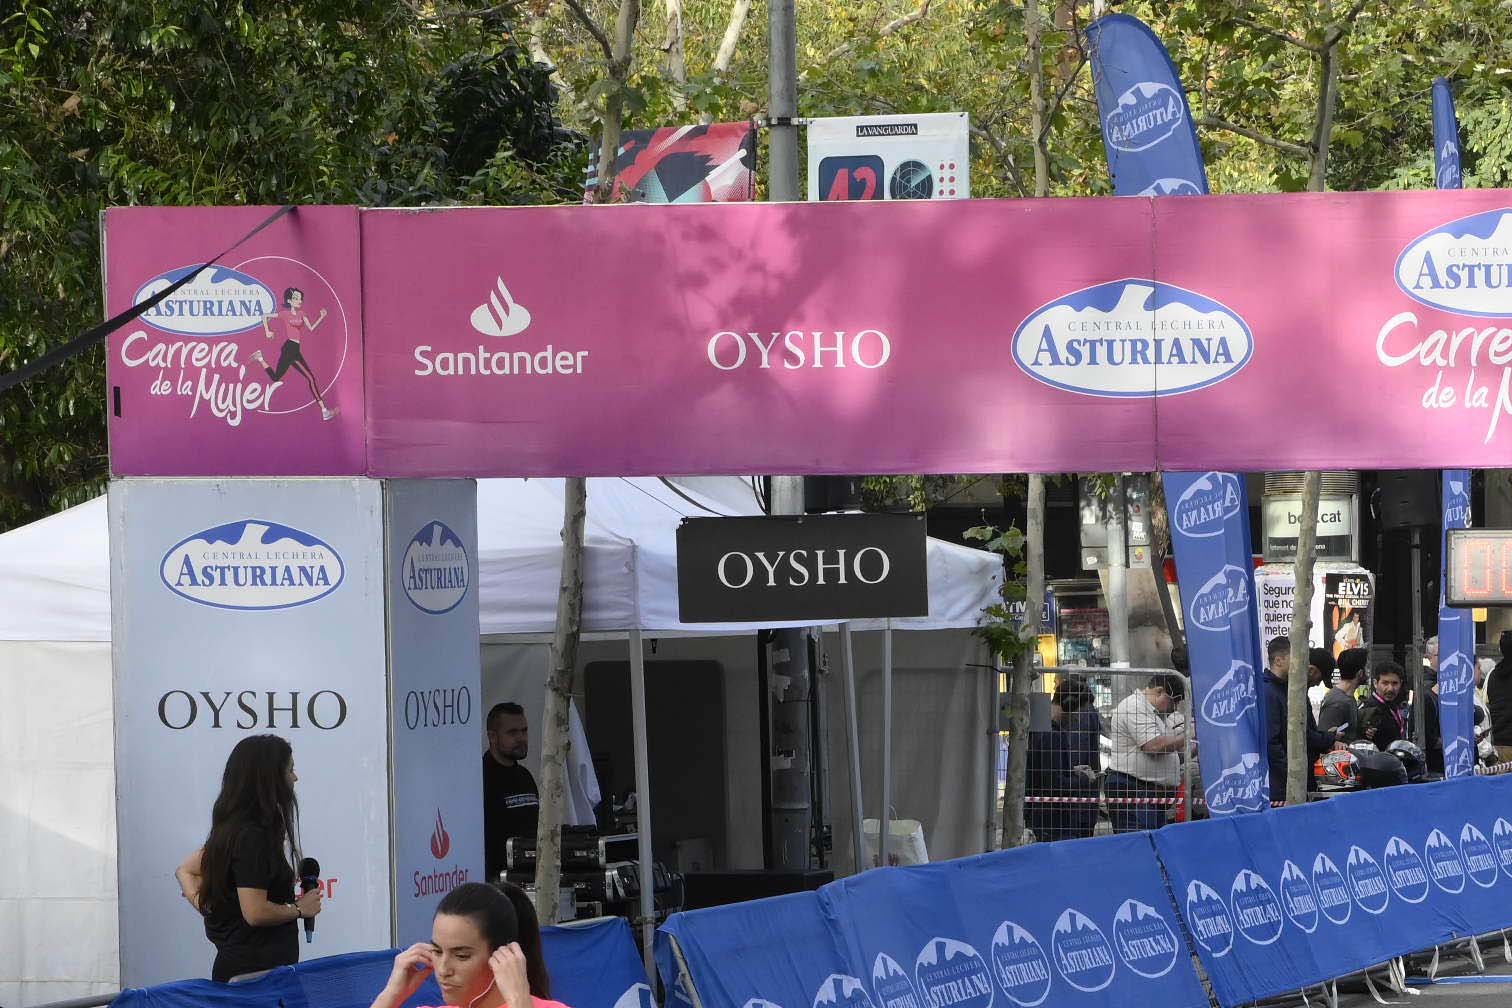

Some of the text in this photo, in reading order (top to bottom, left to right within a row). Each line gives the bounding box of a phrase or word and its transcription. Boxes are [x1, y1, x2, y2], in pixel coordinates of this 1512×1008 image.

[145, 290, 264, 317] ASTURIANA
[172, 289, 210, 297] ENTRAL
[1068, 318, 1226, 332] CENTRAL LECHERA
[121, 330, 239, 369] Carrera
[414, 345, 588, 376] Santander
[707, 329, 891, 371] OYSHO
[1030, 323, 1236, 368] ASTURIANA
[150, 368, 192, 396] de la
[190, 366, 283, 427] Mujer
[1421, 369, 1488, 408] de la
[175, 554, 331, 587] ASTURIANA
[203, 551, 324, 560] CENTRAL LECHERA
[717, 547, 889, 589] OYSHO
[408, 557, 465, 590] ASTURIANA
[1338, 582, 1369, 595] ELVIS
[1264, 600, 1279, 612] que
[1265, 610, 1296, 625] quiere
[158, 690, 347, 729] OYSHO
[406, 686, 470, 730] OYSHO
[414, 864, 468, 898] Santander
[996, 955, 1048, 988] ASTURIANA
[1058, 943, 1112, 974] ASTURIANA
